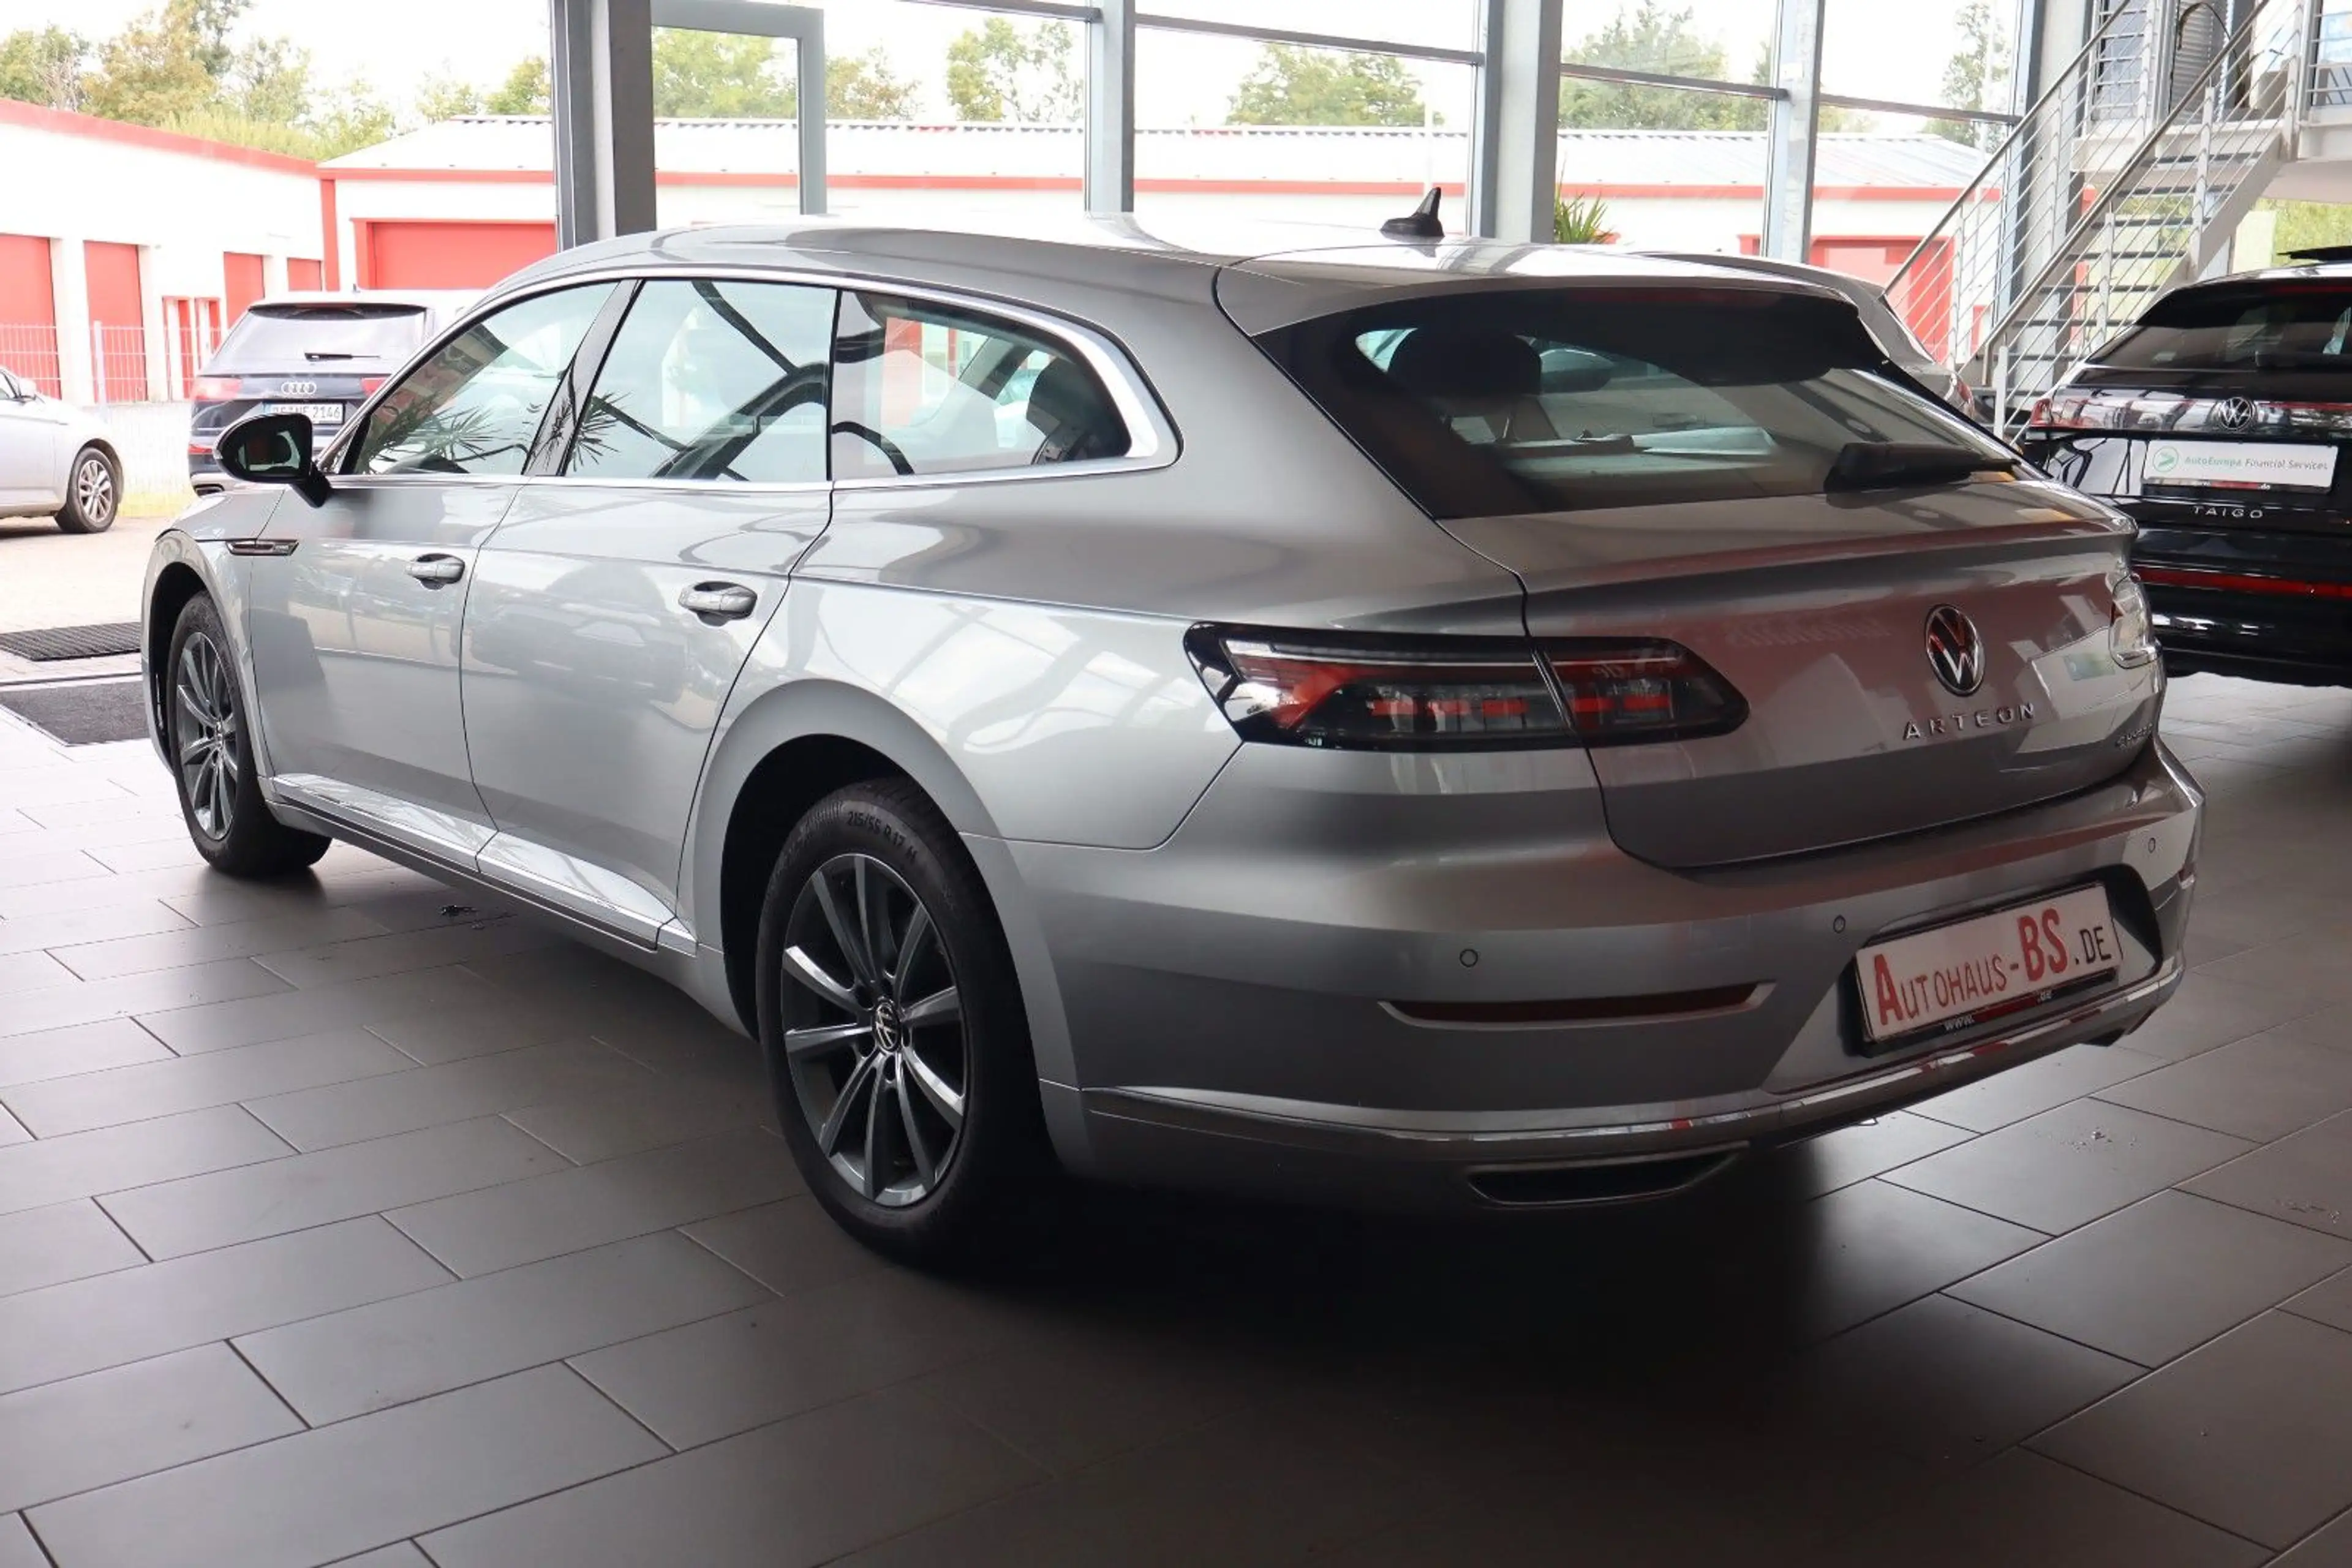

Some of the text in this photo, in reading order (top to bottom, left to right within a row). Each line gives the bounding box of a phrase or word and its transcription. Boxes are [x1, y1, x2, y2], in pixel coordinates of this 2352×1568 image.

[2244, 458, 2286, 469] Financial
[2288, 461, 2328, 470] Services
[2193, 505, 2263, 519] TAIGO
[1902, 703, 2034, 740] ARTEON
